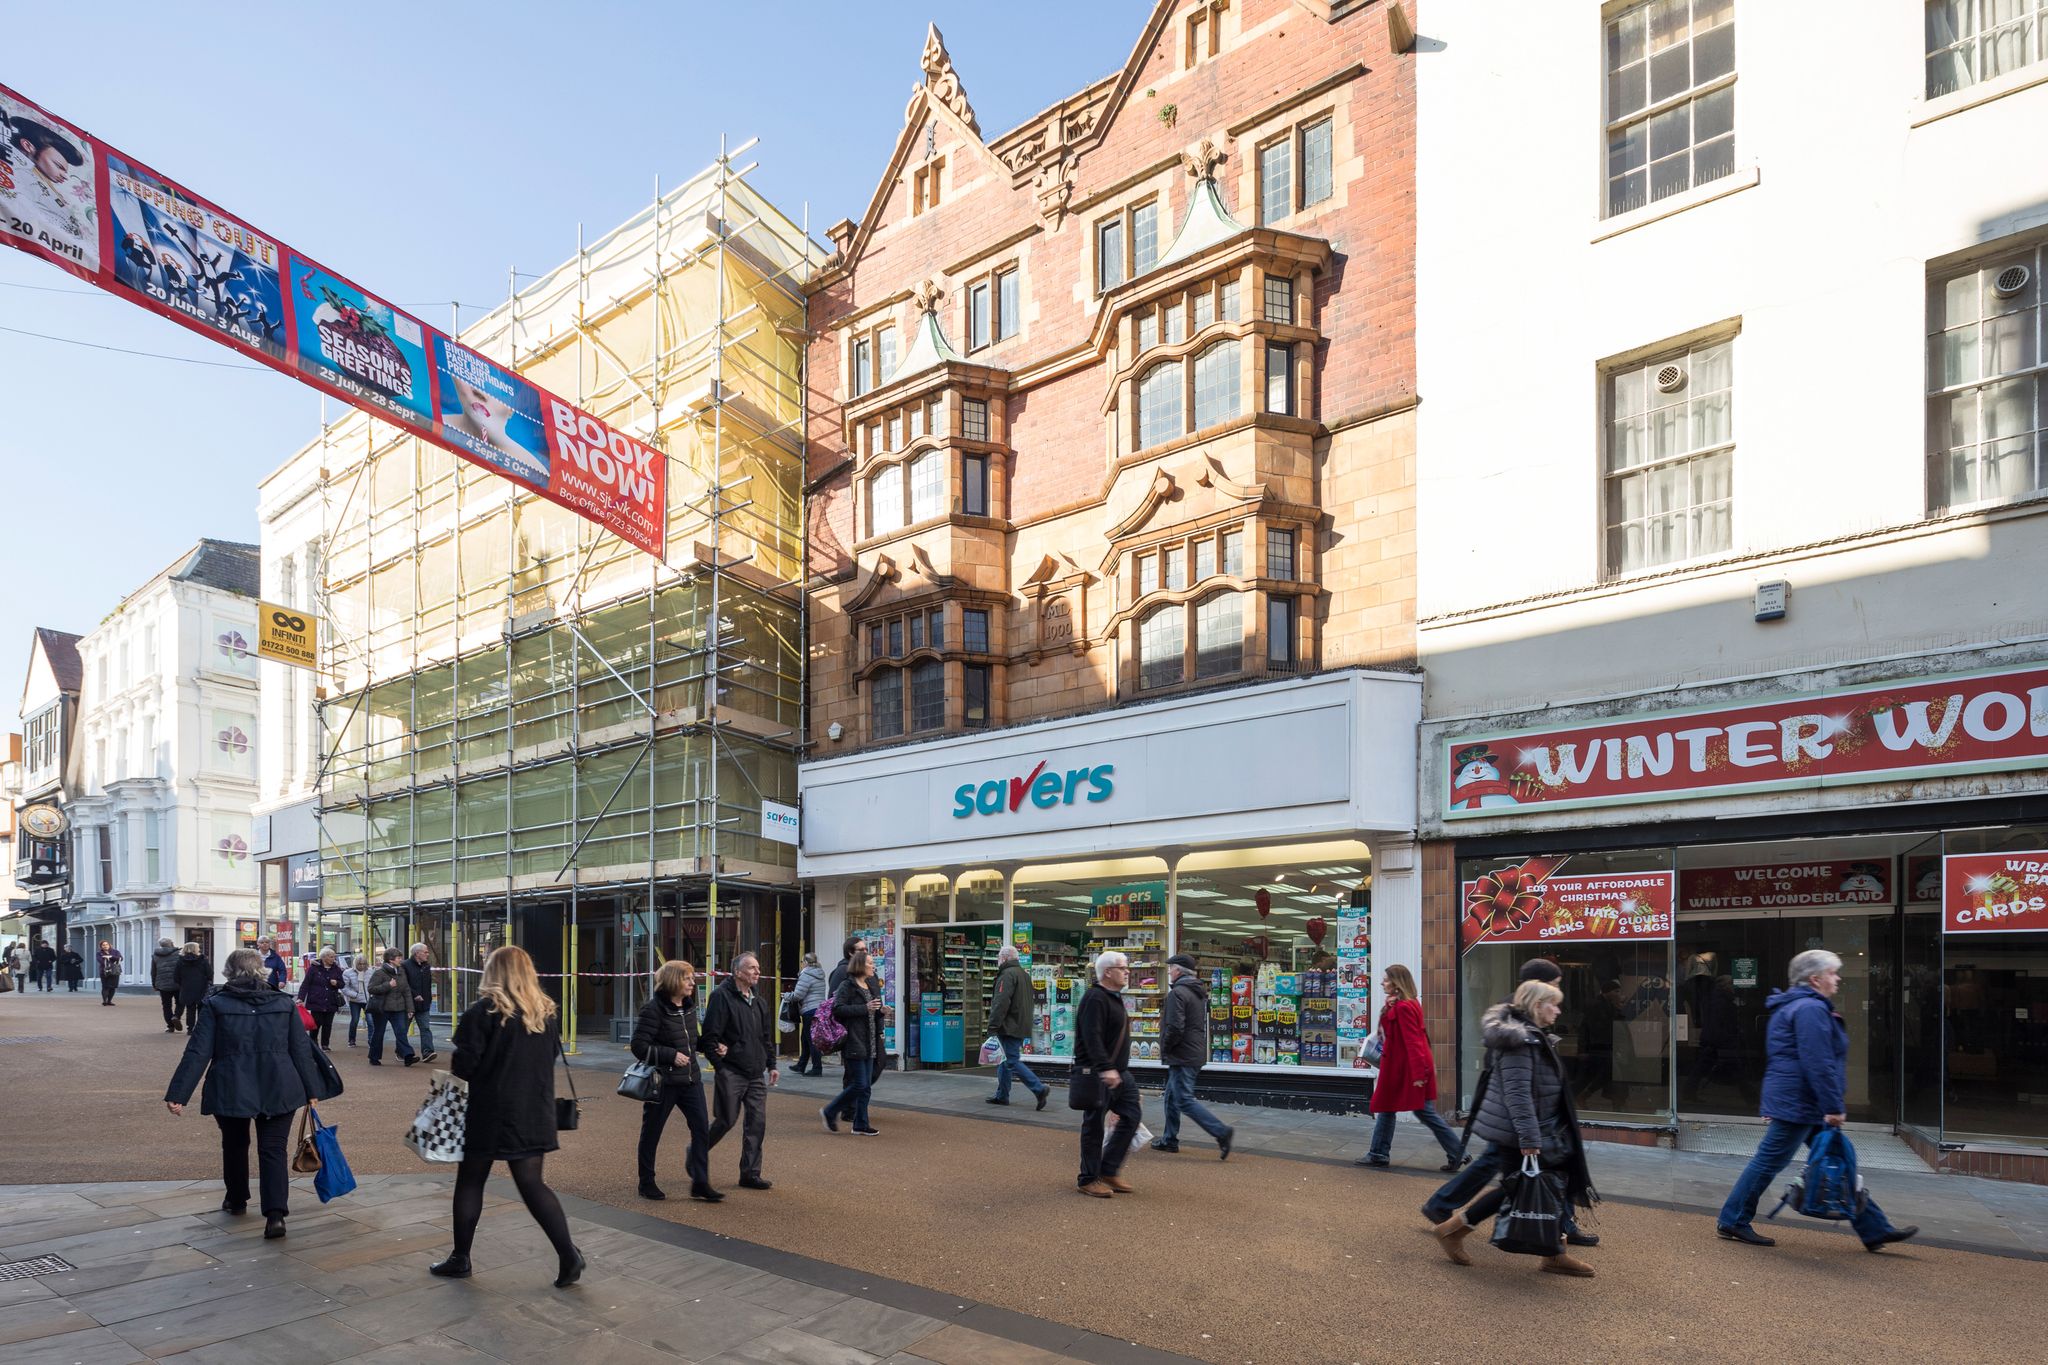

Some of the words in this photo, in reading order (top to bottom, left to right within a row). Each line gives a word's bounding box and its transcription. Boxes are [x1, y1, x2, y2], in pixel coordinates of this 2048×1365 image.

[115, 173, 204, 230] STEPPING
[213, 219, 277, 265] OUT
[11, 217, 34, 236] 20
[38, 231, 84, 261] April
[147, 282, 167, 301] 20
[169, 292, 207, 319] June
[218, 316, 228, 329] 3
[230, 322, 261, 349] Aug
[318, 325, 412, 386] SEASON'S
[443, 340, 490, 374] BIRTHDAYS
[321, 342, 414, 400] GREETINGS
[445, 350, 468, 371] PAST
[470, 363, 515, 397] BIRTHDAYS
[447, 361, 486, 389] PRESENT
[320, 366, 336, 382] 25
[335, 374, 363, 396] July
[371, 391, 387, 406] 28
[388, 399, 416, 421] Sept
[550, 399, 656, 482] BOOK
[466, 439, 473, 450] 4
[474, 442, 498, 461] Sept
[504, 458, 511, 467] 5
[512, 462, 530, 477] Oct
[555, 430, 655, 513] NOW!
[559, 487, 577, 504] Box
[579, 497, 605, 520] Office
[272, 628, 306, 645] INFINITI
[1046, 622, 1073, 641] 1900
[261, 640, 284, 651] 01723
[286, 645, 300, 655] 500
[301, 650, 315, 660] 888
[1532, 713, 1834, 788] WINTER
[953, 759, 1115, 819] savers
[766, 812, 798, 826] savers
[1526, 885, 1548, 893] FOR
[1552, 883, 1582, 892] YOUR
[1586, 878, 1665, 890] AFFORDABLE
[1734, 865, 1833, 881] WELCOME
[1773, 882, 1793, 891] TO
[1560, 892, 1627, 902] CHRISTMAS
[1689, 896, 1753, 908] WINTER
[1759, 891, 1884, 905] WONDERLAND
[1956, 896, 2046, 924] CARDS
[1584, 907, 1620, 919] HATS
[1618, 914, 1669, 926] GLOVES
[1539, 921, 1585, 938] SOCKS
[1618, 926, 1629, 935] &
[1633, 922, 1670, 934] BAGS
